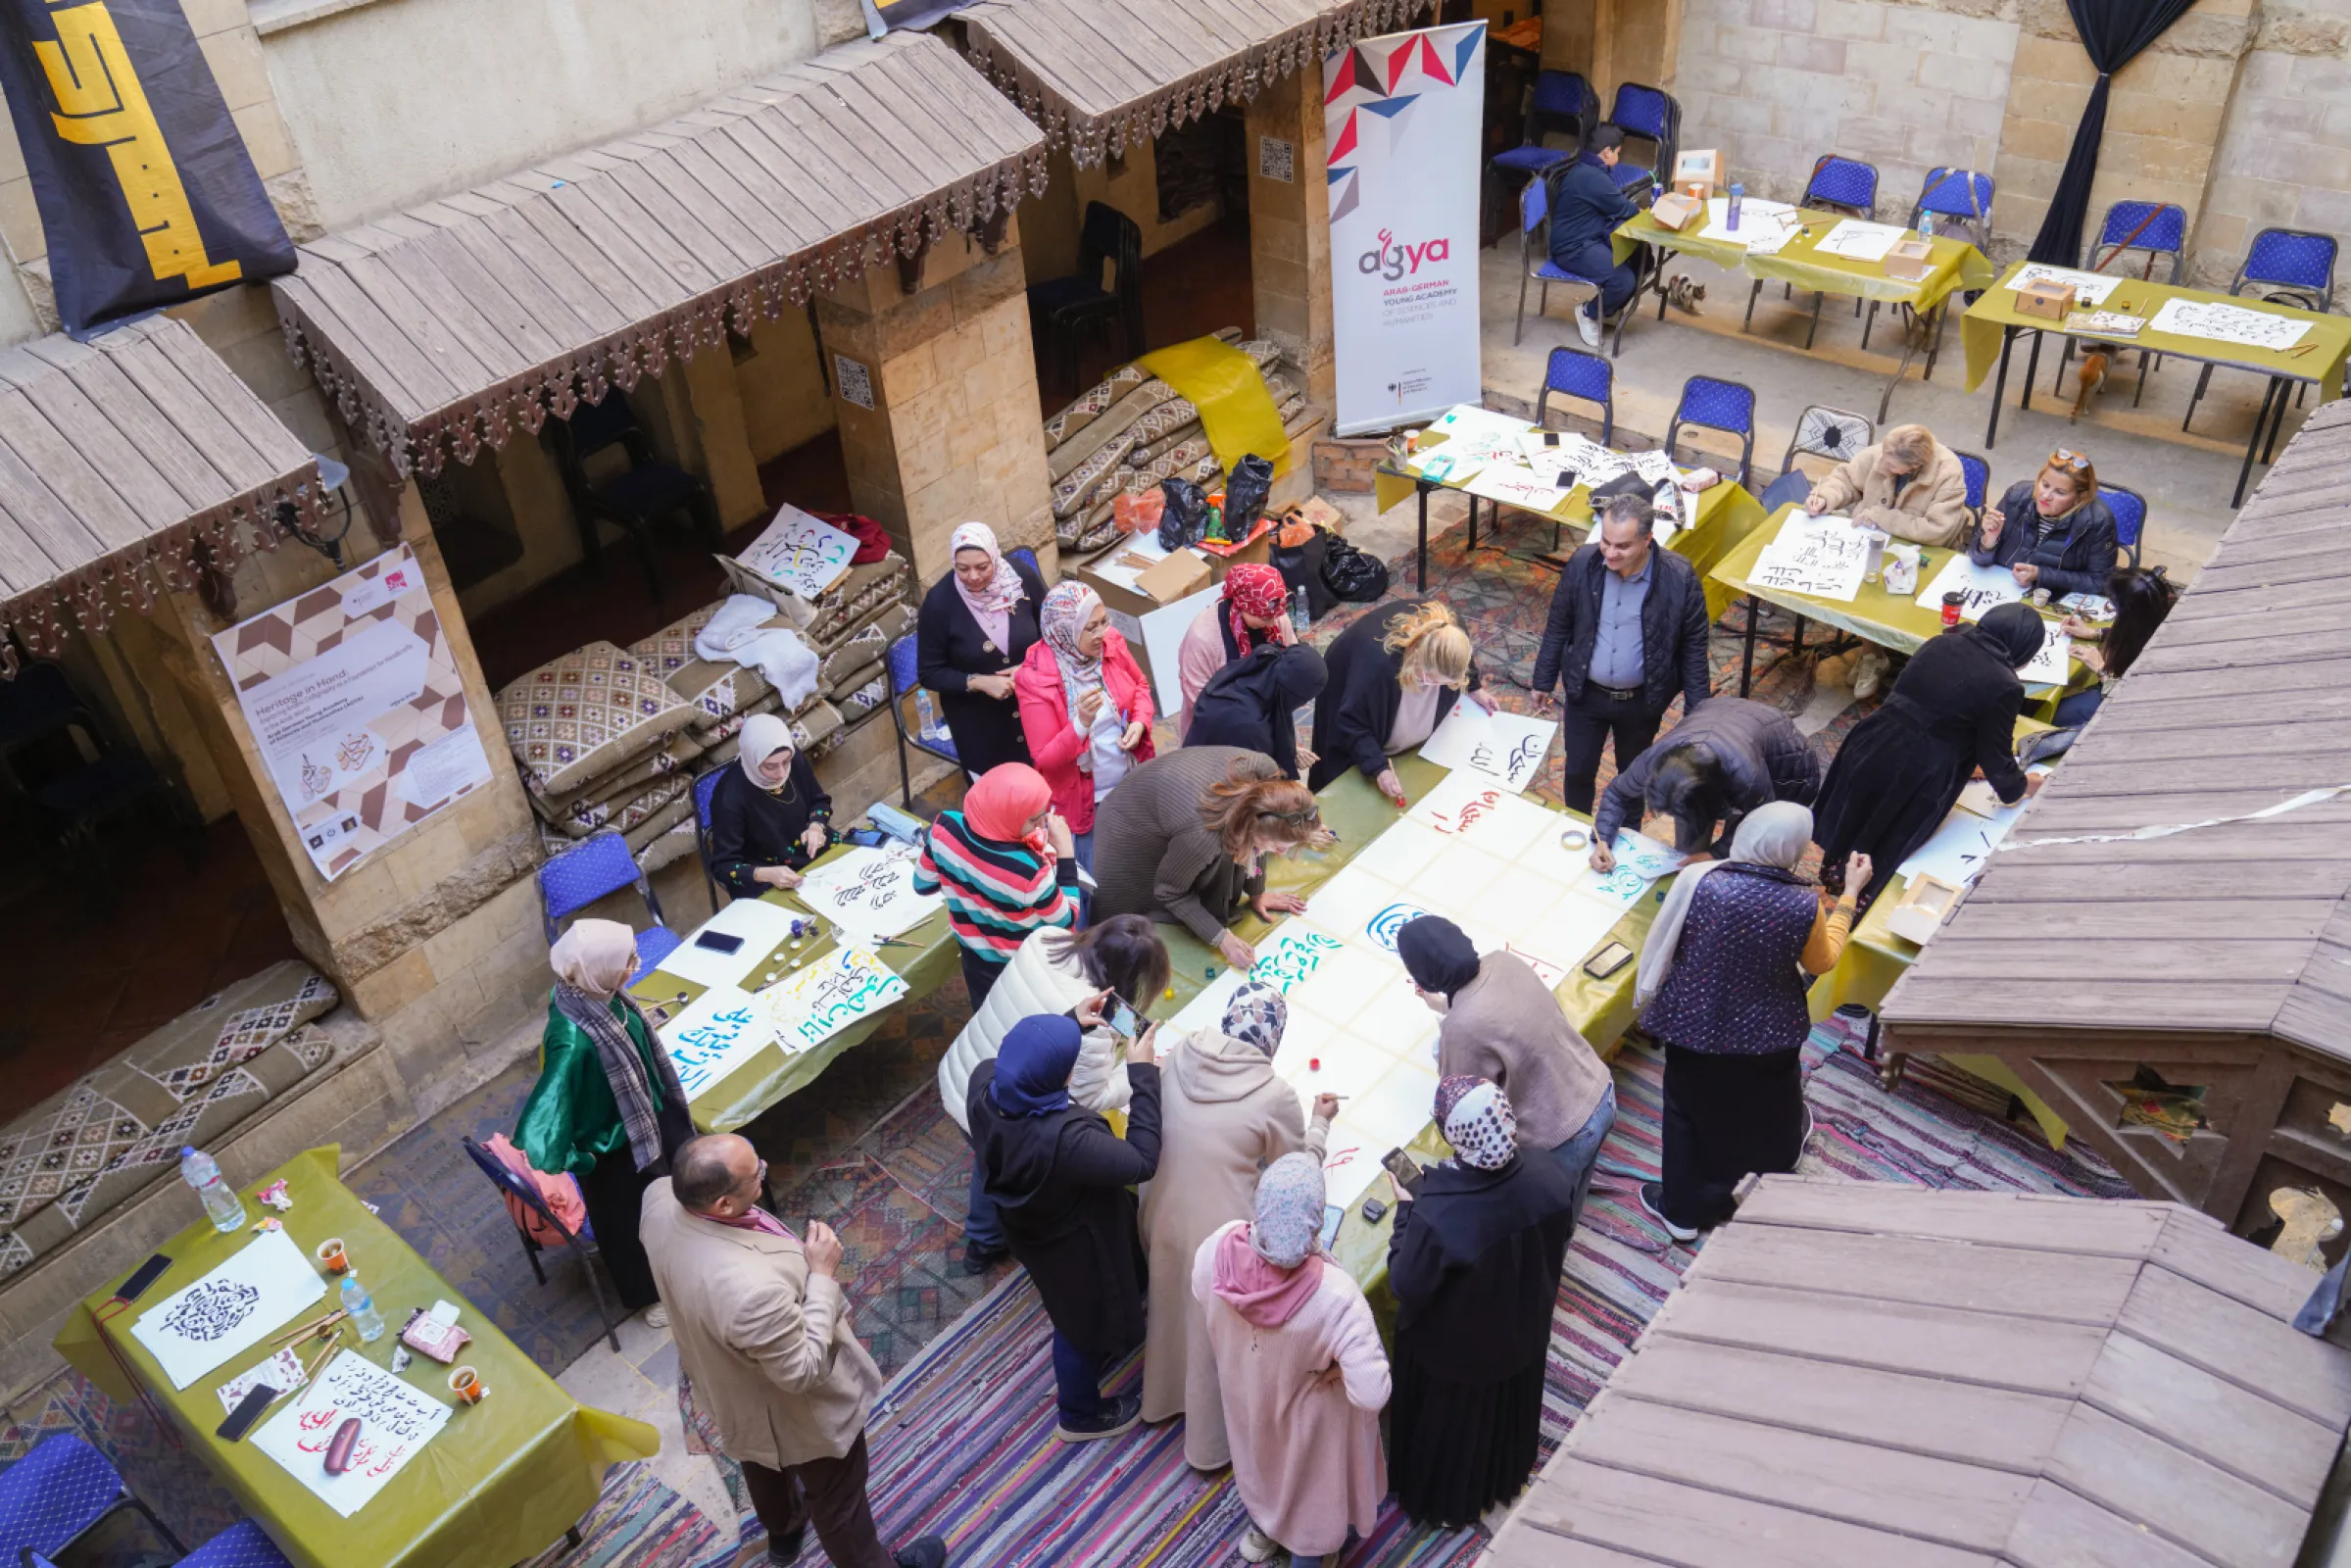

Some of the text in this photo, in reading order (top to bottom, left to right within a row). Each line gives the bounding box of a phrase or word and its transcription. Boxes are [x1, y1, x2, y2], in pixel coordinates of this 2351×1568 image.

[1359, 228, 1449, 281] agya
[1383, 287, 1458, 306] YOUNG ACADEMY
[1439, 297, 1457, 307] AND
[1383, 313, 1434, 327] HUMANITIES
[255, 692, 303, 717] Heritage
[304, 684, 316, 694] in
[317, 669, 349, 688] Hand:
